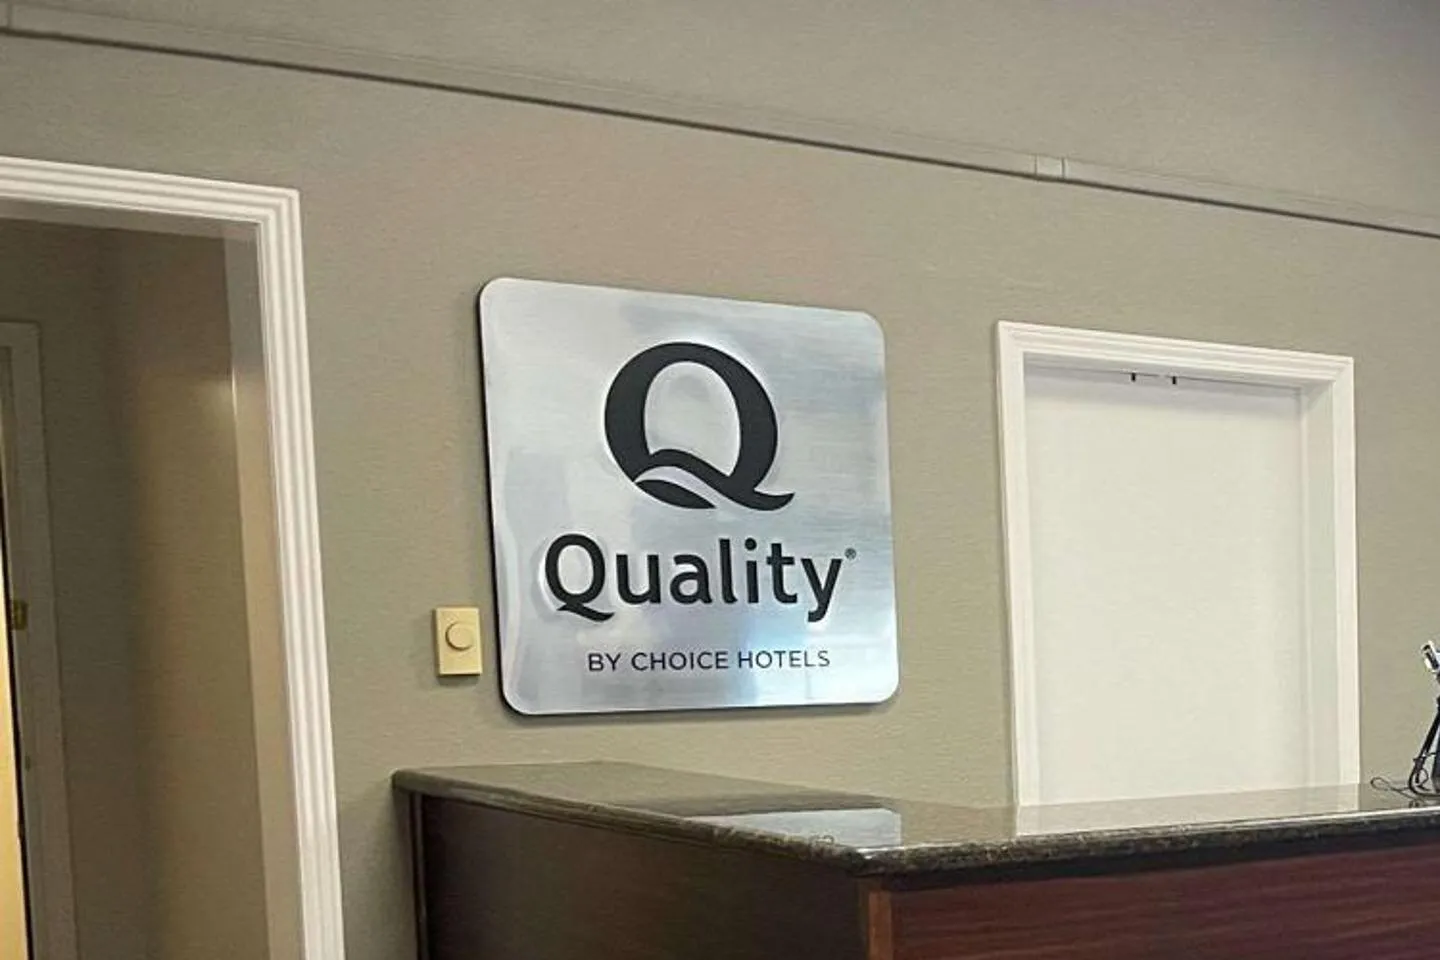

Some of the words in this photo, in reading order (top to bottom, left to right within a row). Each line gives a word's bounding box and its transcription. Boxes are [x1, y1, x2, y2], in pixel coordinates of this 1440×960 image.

[604, 341, 795, 511] Q
[588, 653, 621, 672] BY
[631, 651, 729, 671] CHOICE
[738, 650, 831, 670] HOTELS
